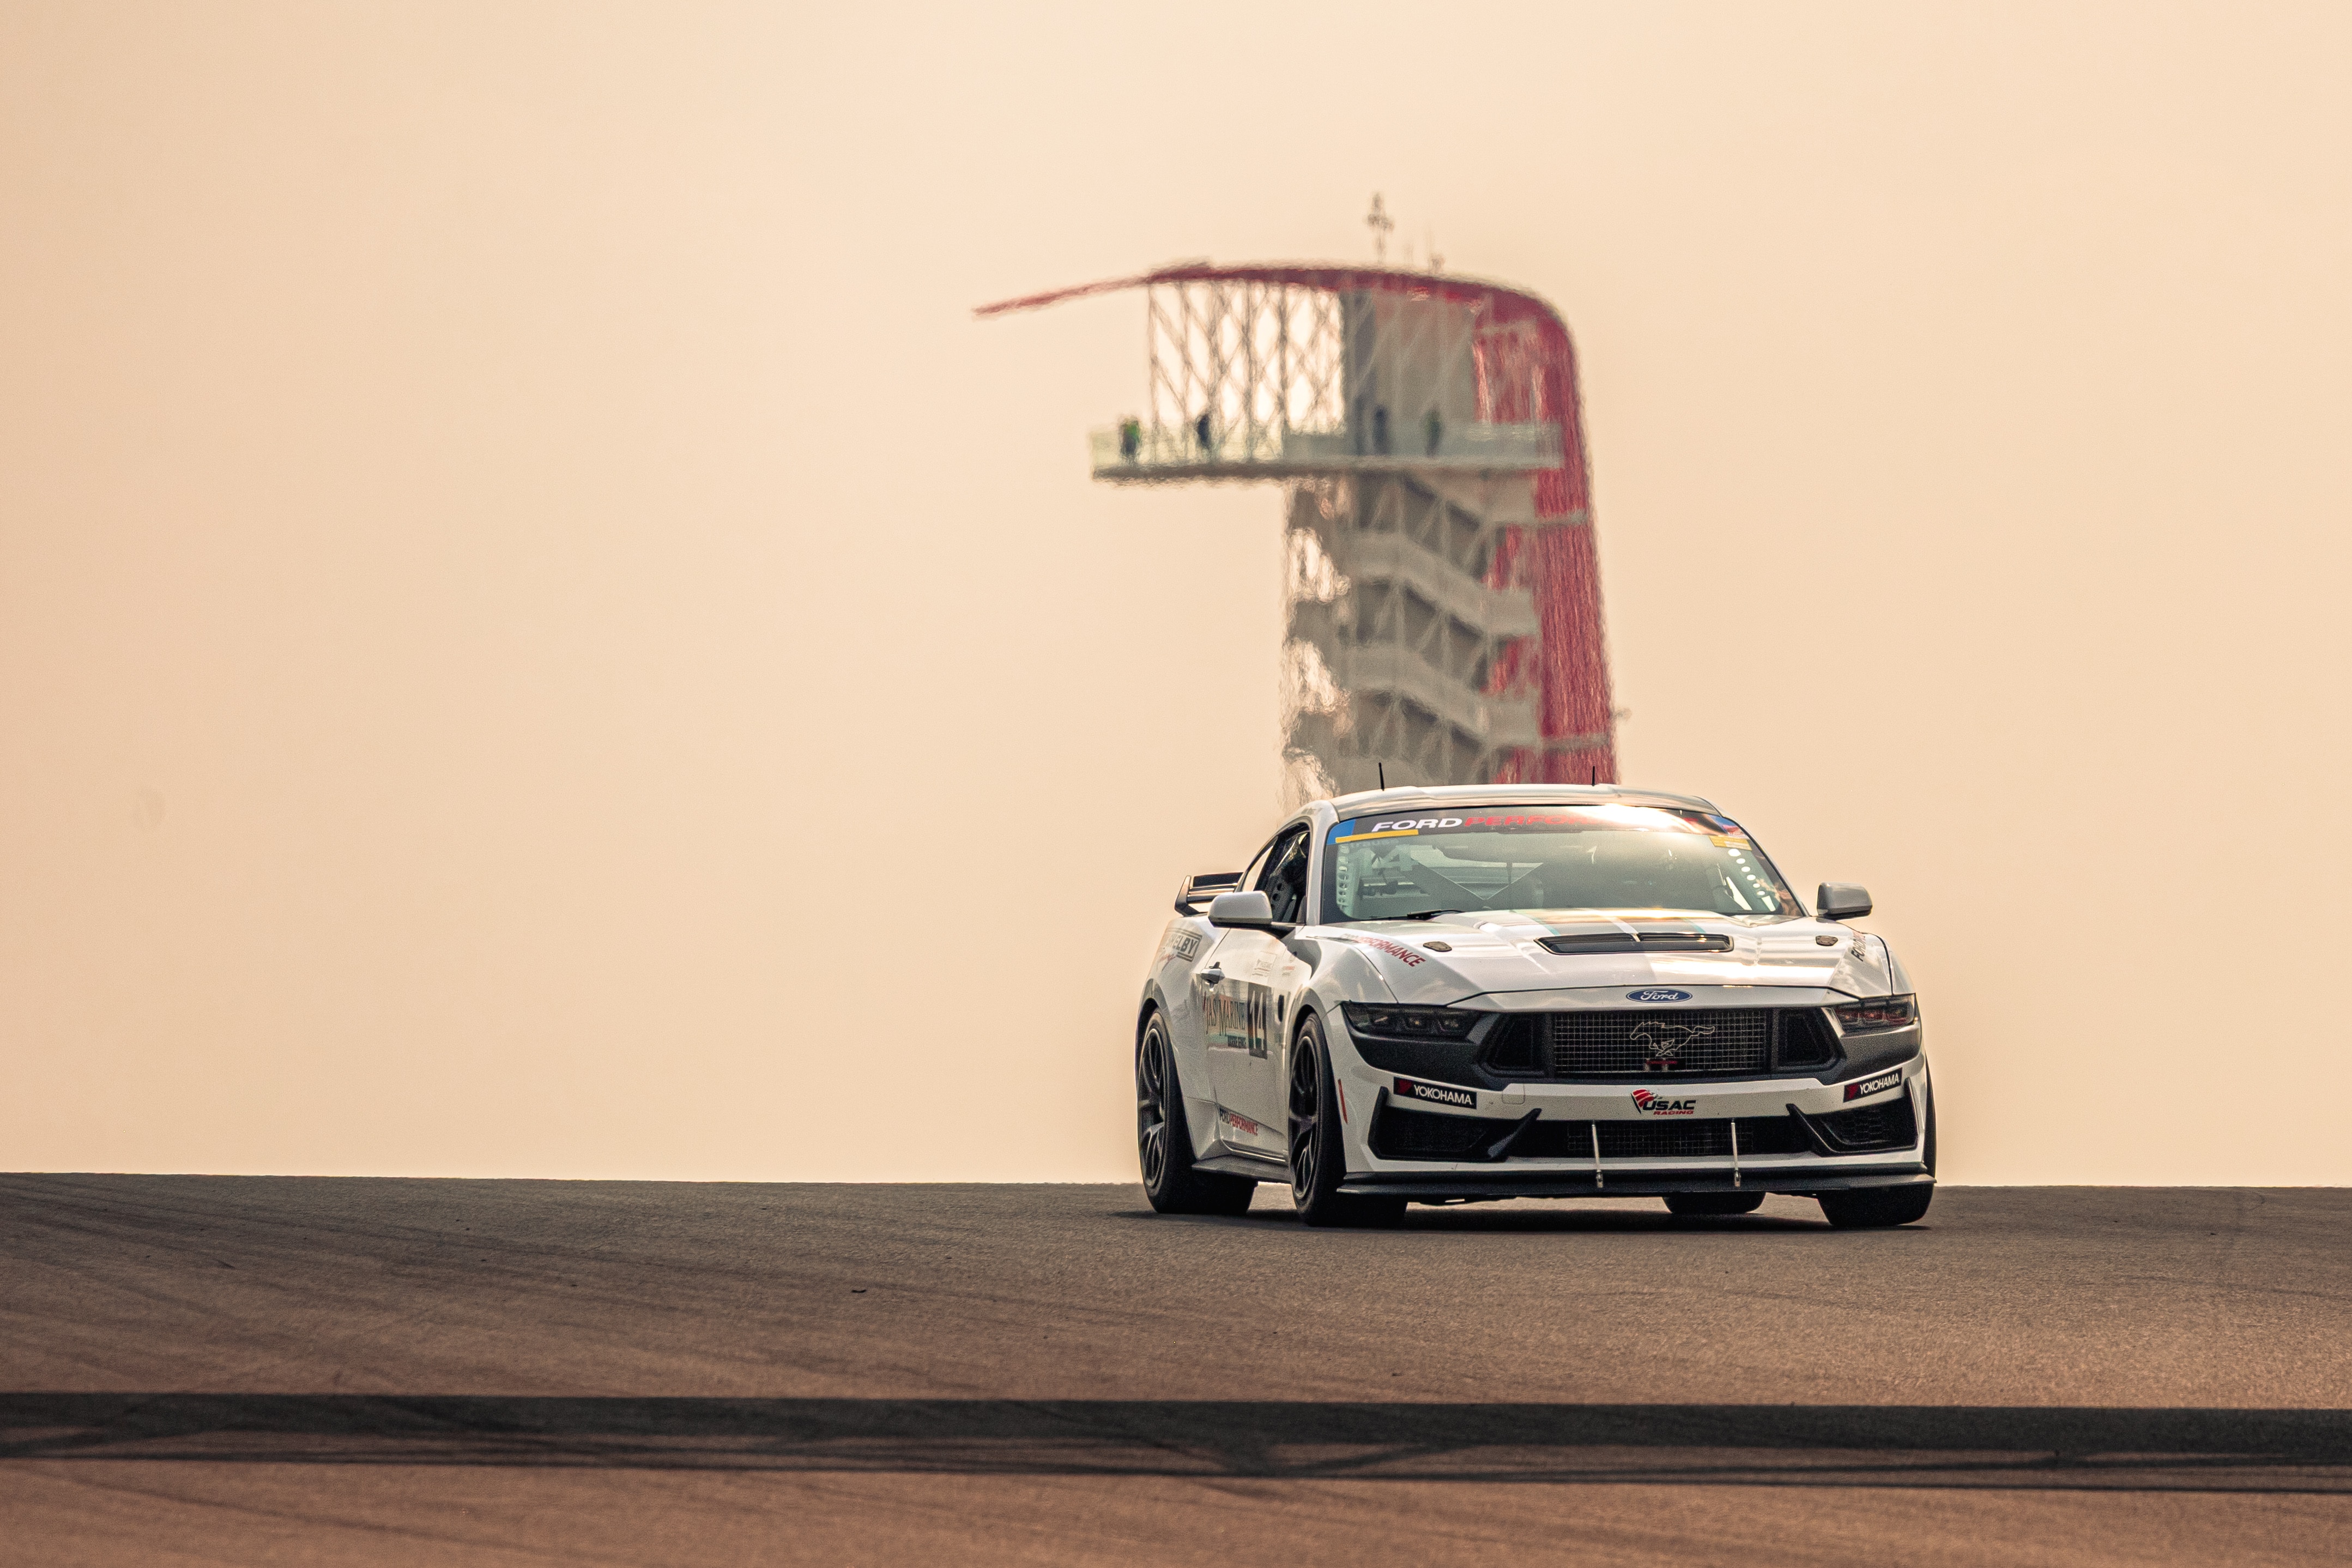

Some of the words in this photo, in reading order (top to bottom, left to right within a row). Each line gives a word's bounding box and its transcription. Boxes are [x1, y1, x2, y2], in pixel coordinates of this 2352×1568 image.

[1371, 818, 1463, 832] FORD
[1640, 990, 1679, 1000] Ford
[1218, 999, 1245, 1037] MARINE
[1250, 990, 1265, 1051] 14
[1860, 1073, 1899, 1095] YOKOHAMA
[1414, 1085, 1472, 1105] YOKOHAMA
[1642, 1100, 1696, 1111] USAC
